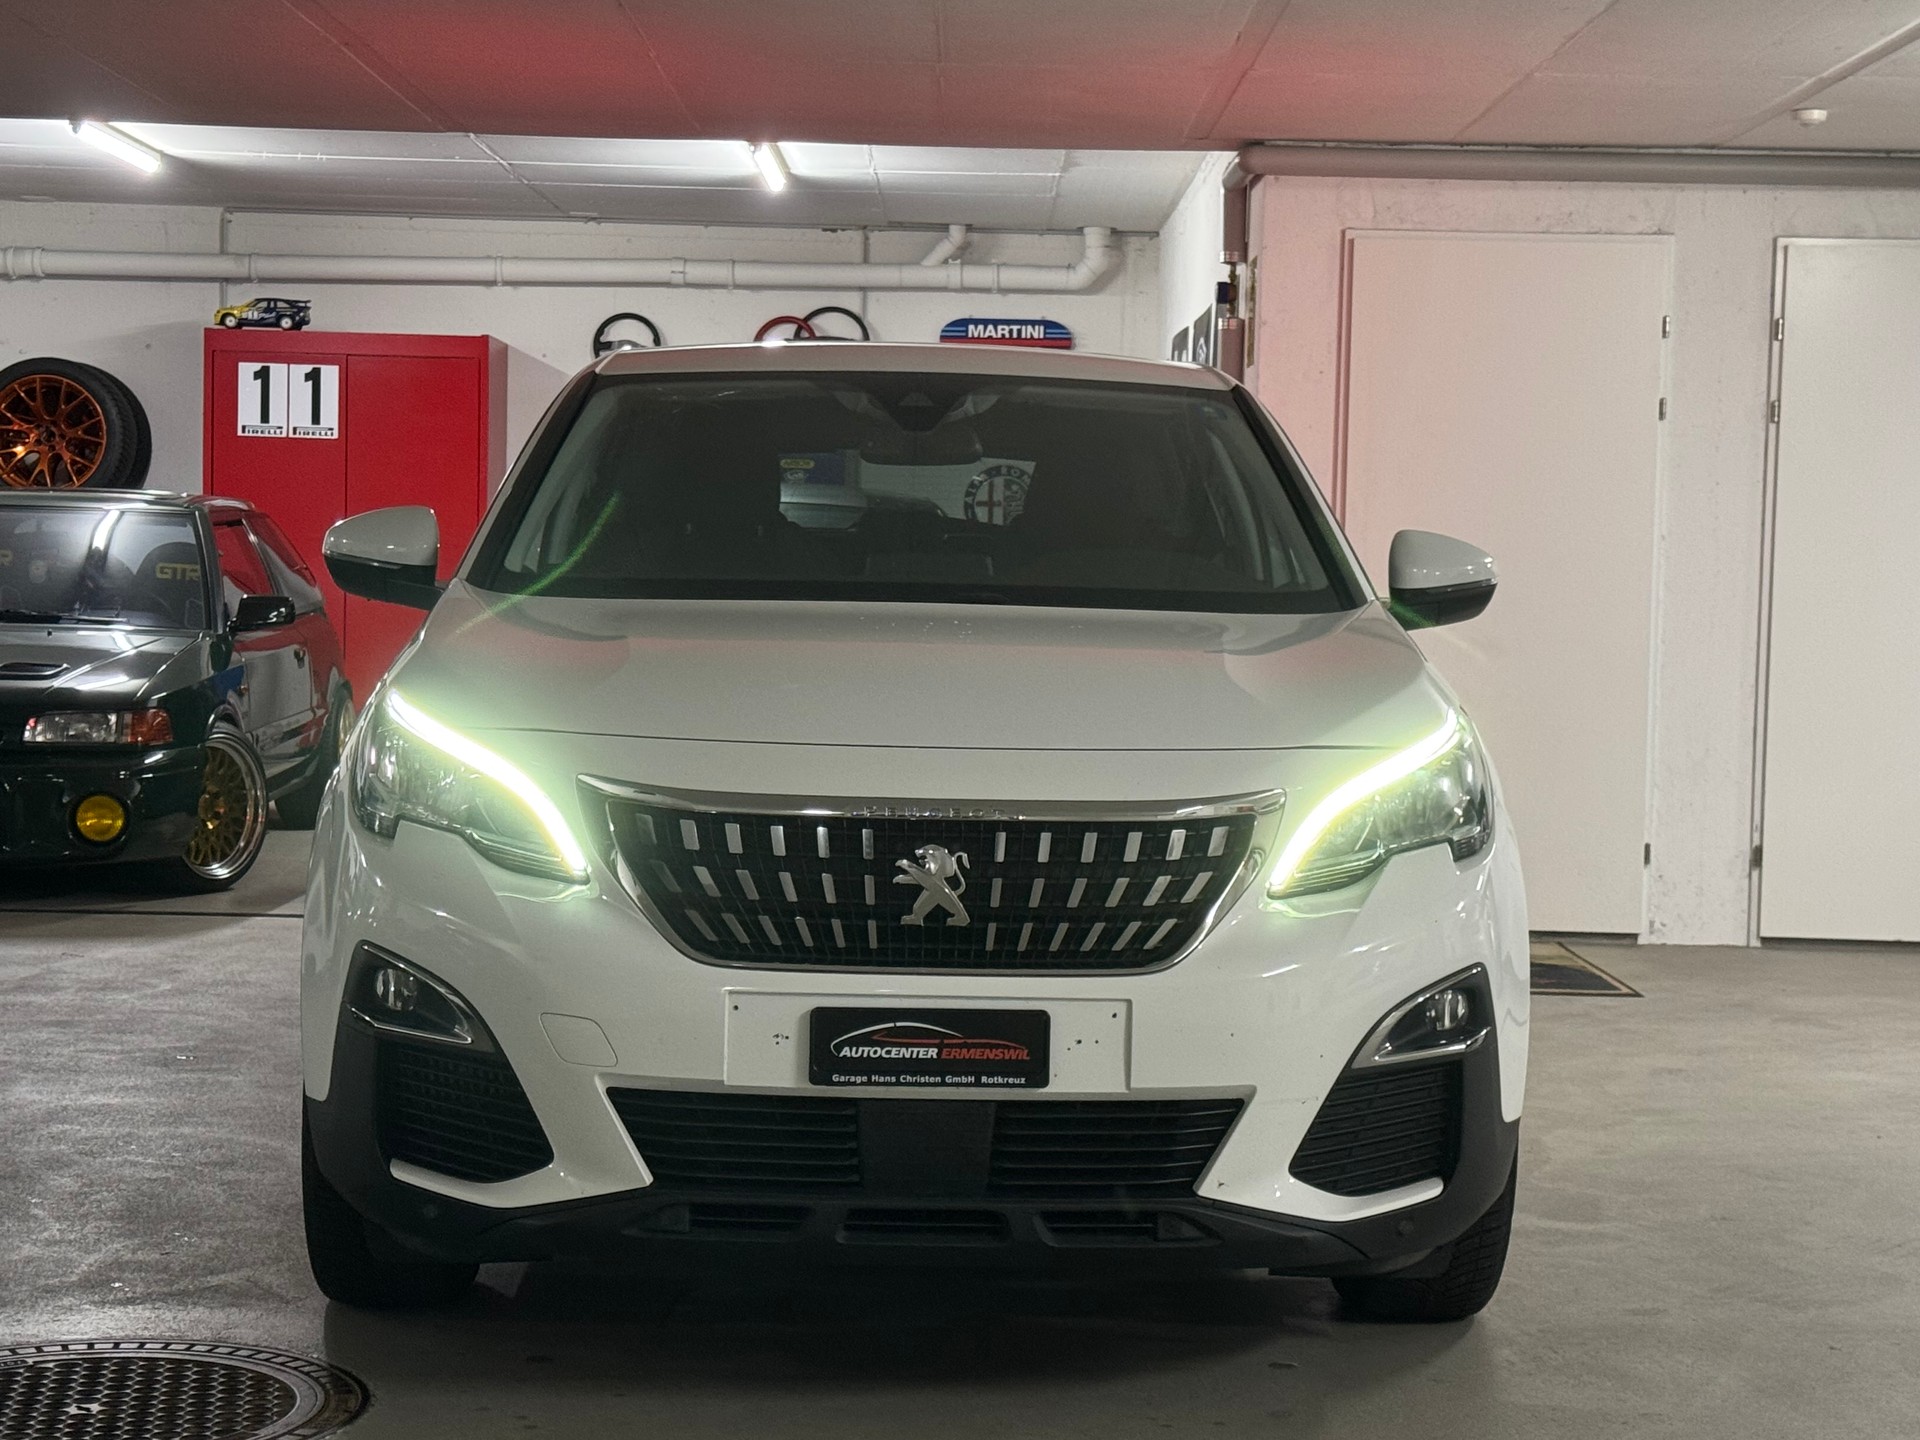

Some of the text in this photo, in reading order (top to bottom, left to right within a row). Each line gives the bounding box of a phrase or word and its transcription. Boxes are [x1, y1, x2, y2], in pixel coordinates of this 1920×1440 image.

[968, 324, 1044, 339] MARTINI
[242, 425, 283, 435] PIRELLI
[293, 426, 334, 437] PIRELLI
[155, 562, 199, 581] GTR
[863, 806, 1005, 818] PEUGEOT
[839, 1047, 1030, 1060] AUTOCENTER ERMENSWIL
[832, 1074, 1026, 1084] Garage Hans Christen GmbH Rotkreuz
